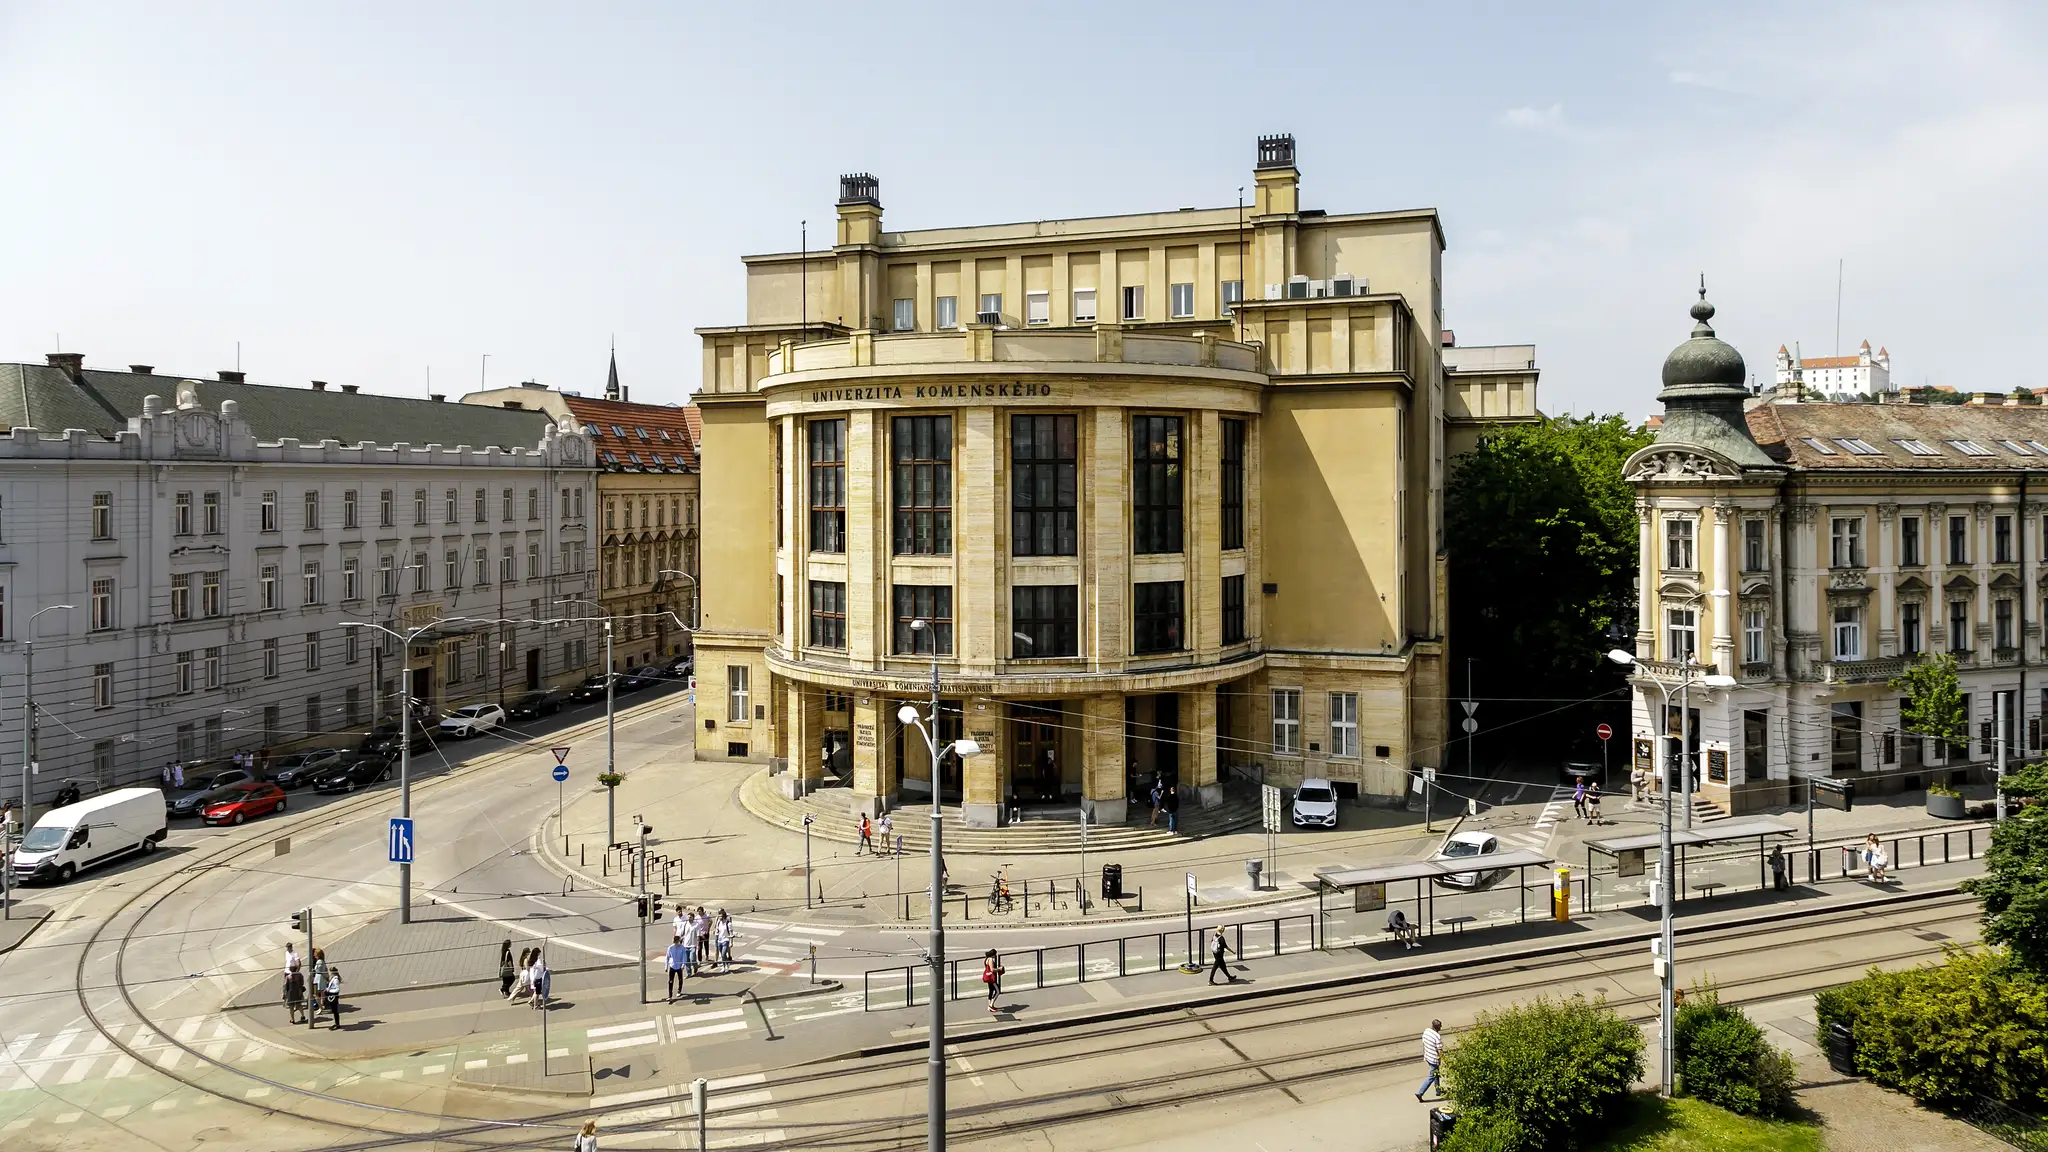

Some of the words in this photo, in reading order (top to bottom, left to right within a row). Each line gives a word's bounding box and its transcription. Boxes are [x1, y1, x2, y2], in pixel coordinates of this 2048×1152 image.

[812, 387, 902, 403] UNIVERZITA
[916, 381, 1051, 398] KOMENSKÉHO
[852, 679, 889, 690] UNIVERSITAS
[894, 681, 933, 693] COMENIAN
